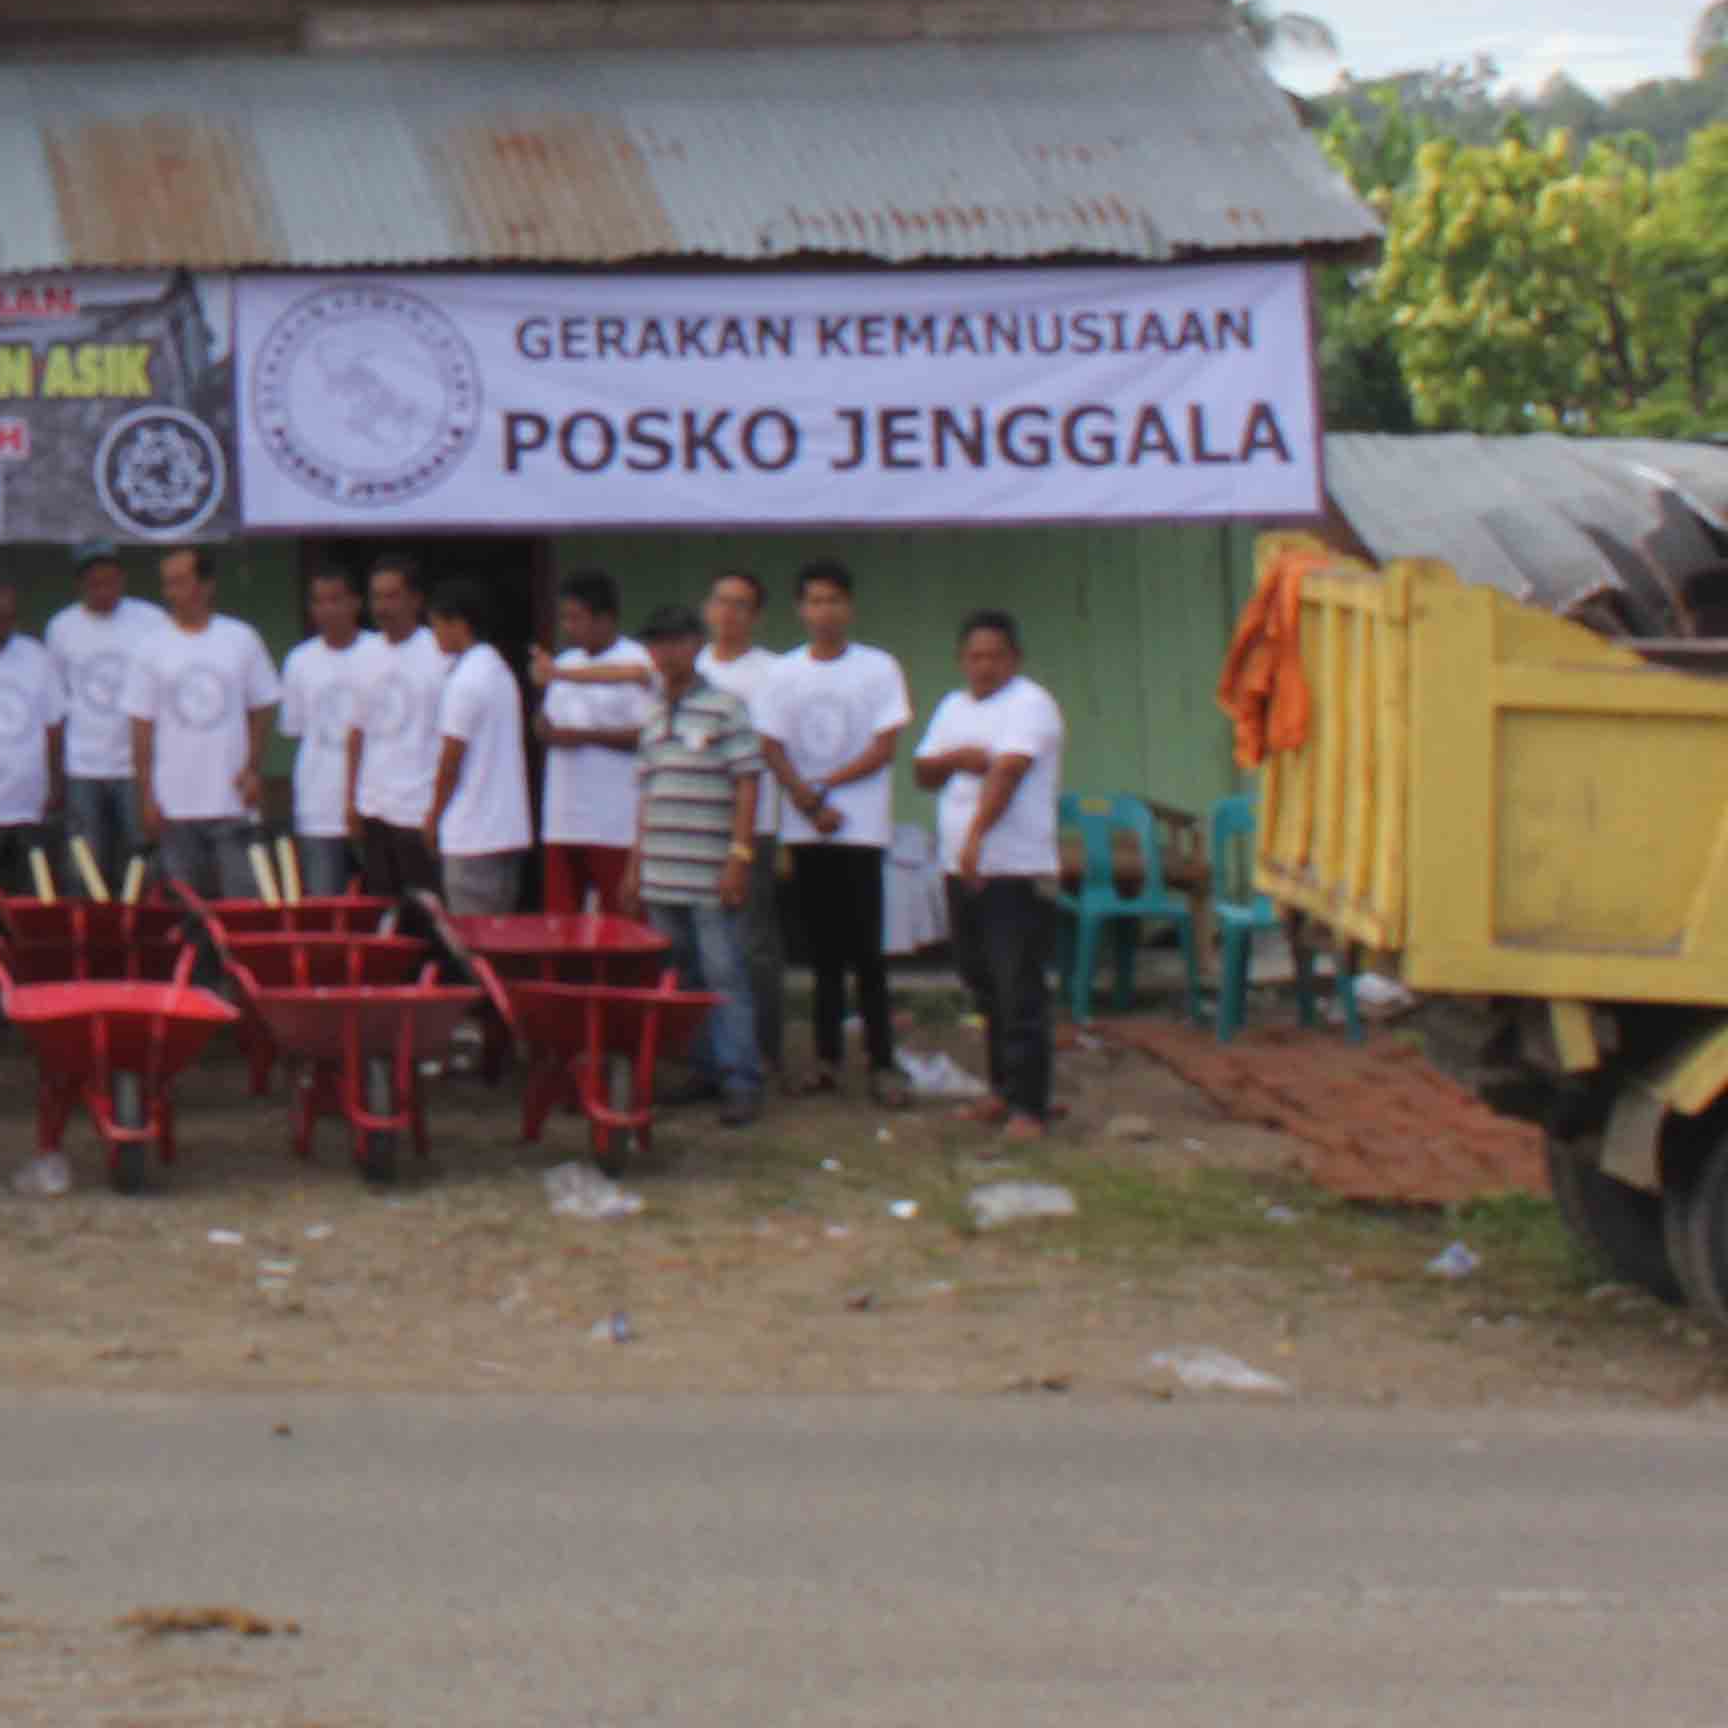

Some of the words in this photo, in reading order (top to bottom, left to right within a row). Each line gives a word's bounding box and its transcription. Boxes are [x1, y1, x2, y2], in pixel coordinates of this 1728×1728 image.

[513, 314, 793, 362] GERAKAN
[816, 308, 1253, 357] KEMANUSIAAN
[44, 342, 152, 399] ASIK
[501, 407, 799, 473] POSKO
[829, 399, 1293, 472] JENGGALA
